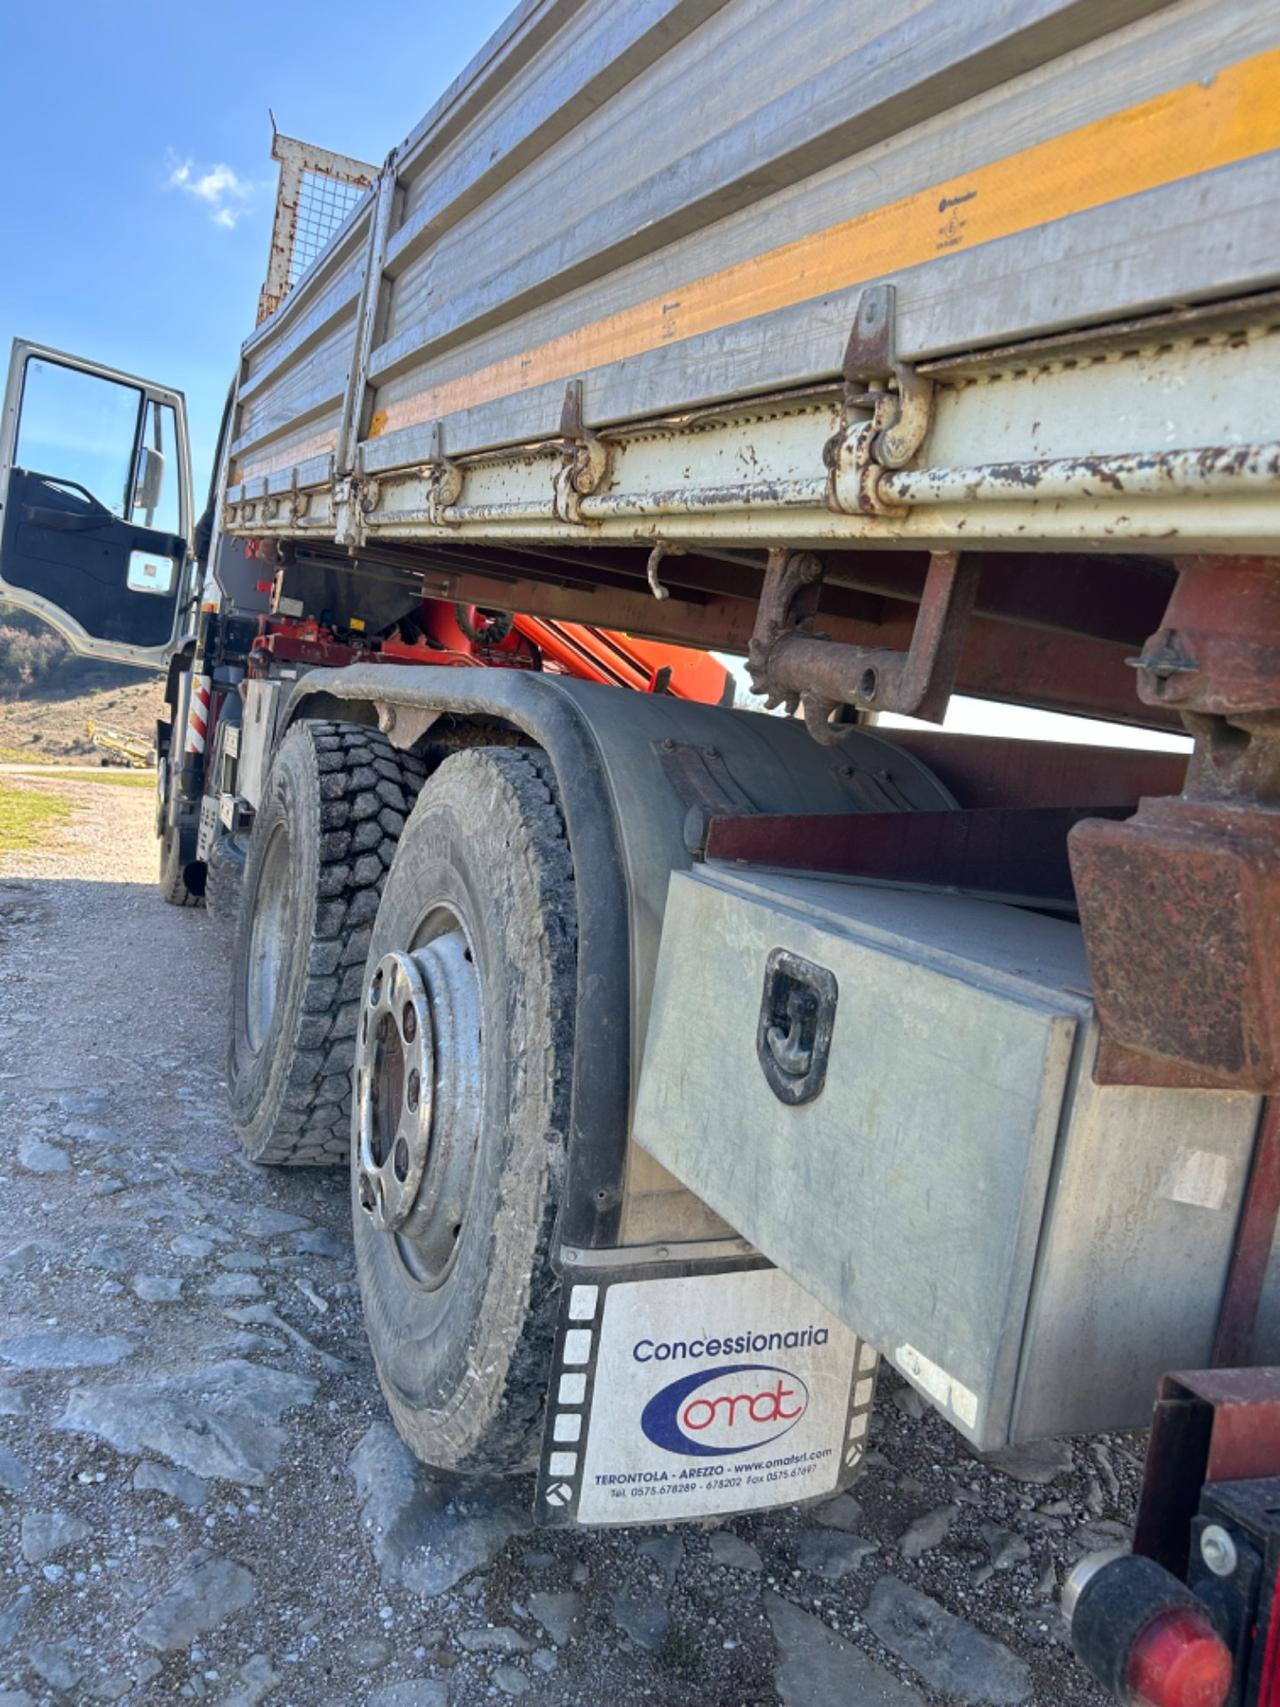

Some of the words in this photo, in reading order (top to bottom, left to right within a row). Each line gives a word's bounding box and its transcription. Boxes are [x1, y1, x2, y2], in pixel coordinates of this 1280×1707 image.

[633, 1325, 829, 1362] Concessionaria
[595, 1471, 668, 1485] TERONTOLA
[679, 1465, 724, 1480] AREZZO
[734, 1448, 832, 1473] www.omatsrl.com
[706, 1477, 742, 1490] 678202
